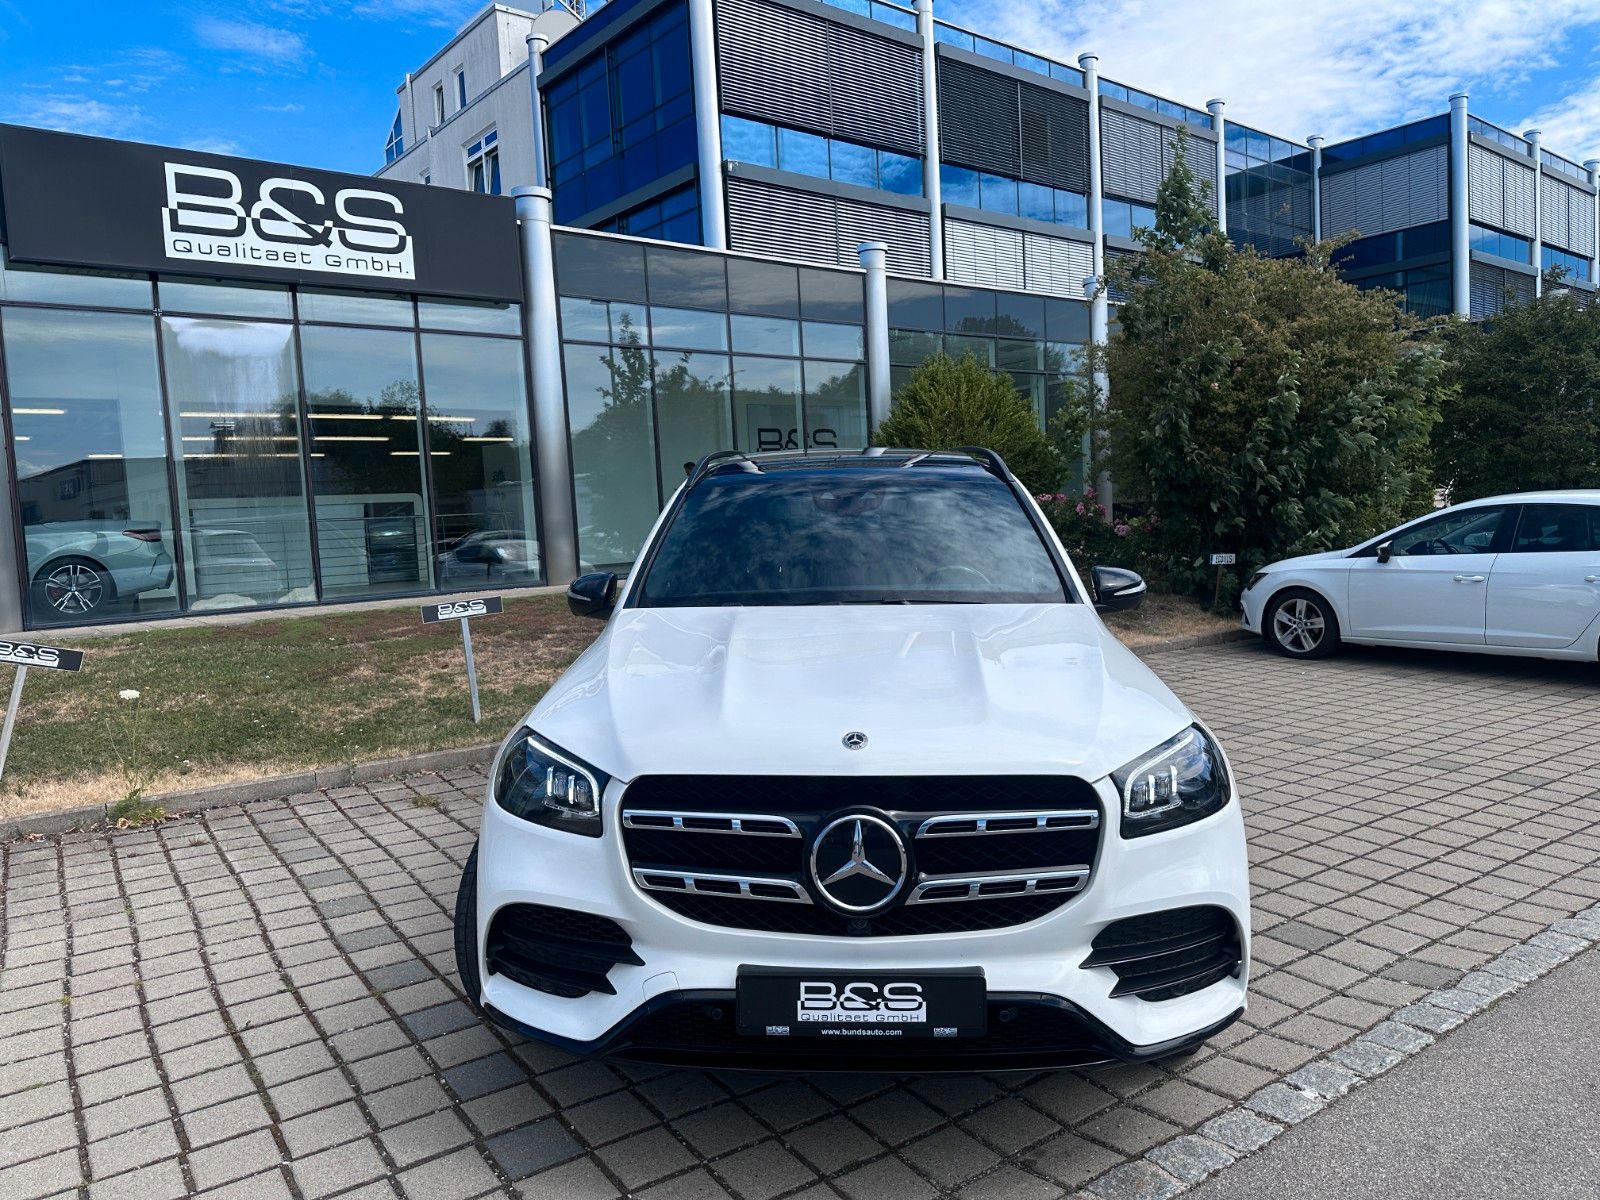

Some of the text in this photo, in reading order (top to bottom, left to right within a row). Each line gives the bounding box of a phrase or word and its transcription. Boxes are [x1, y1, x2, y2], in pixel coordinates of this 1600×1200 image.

[164, 162, 407, 254] B&S
[173, 239, 409, 274] Qualitaet GmbH.
[438, 599, 485, 615] B&S
[800, 982, 923, 1011] B&S
[801, 1013, 868, 1021] Qualitaet
[821, 1028, 902, 1036] www.bundsauto.com
